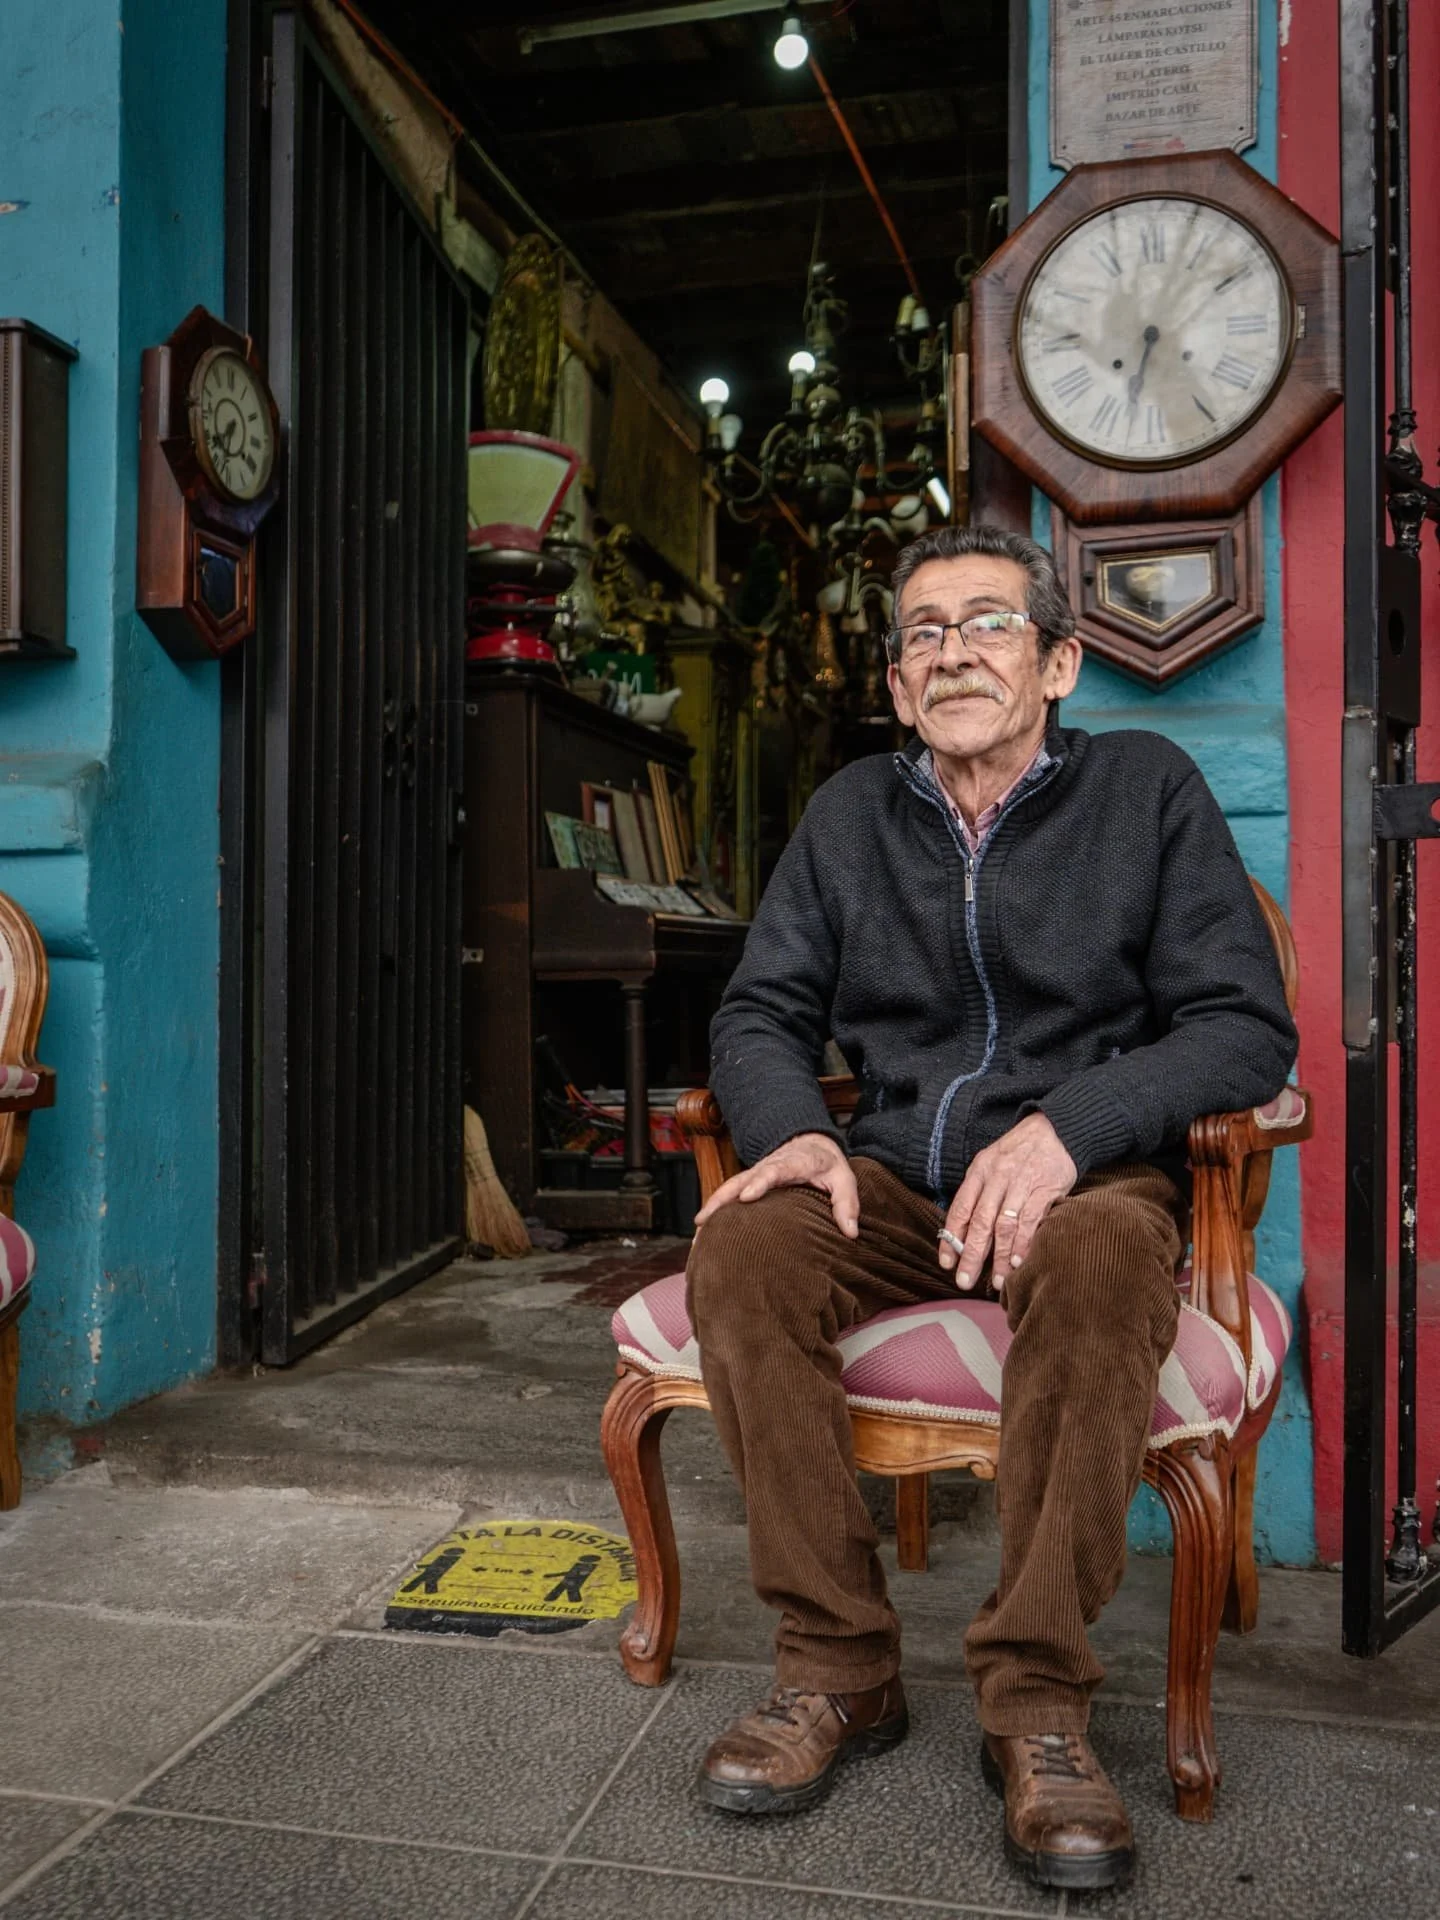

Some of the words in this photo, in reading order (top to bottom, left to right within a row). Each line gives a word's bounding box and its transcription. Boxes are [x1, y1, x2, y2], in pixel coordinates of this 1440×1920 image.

[1073, 14, 1105, 28] ARTE
[1123, 0, 1233, 22] ENMARCACIONES
[1080, 54, 1095, 66] EL
[1097, 49, 1143, 64] TALLER
[1145, 47, 1163, 59] DE
[1164, 40, 1227, 57] CASTILLO
[1115, 71, 1130, 82] EL
[1131, 64, 1192, 80] PLATERO
[1106, 88, 1161, 103] IMPERIO
[1105, 109, 1147, 122] BAZAR
[1148, 107, 1166, 119] DE
[1168, 102, 1201, 118] ARTE
[503, 1526, 542, 1538] LA
